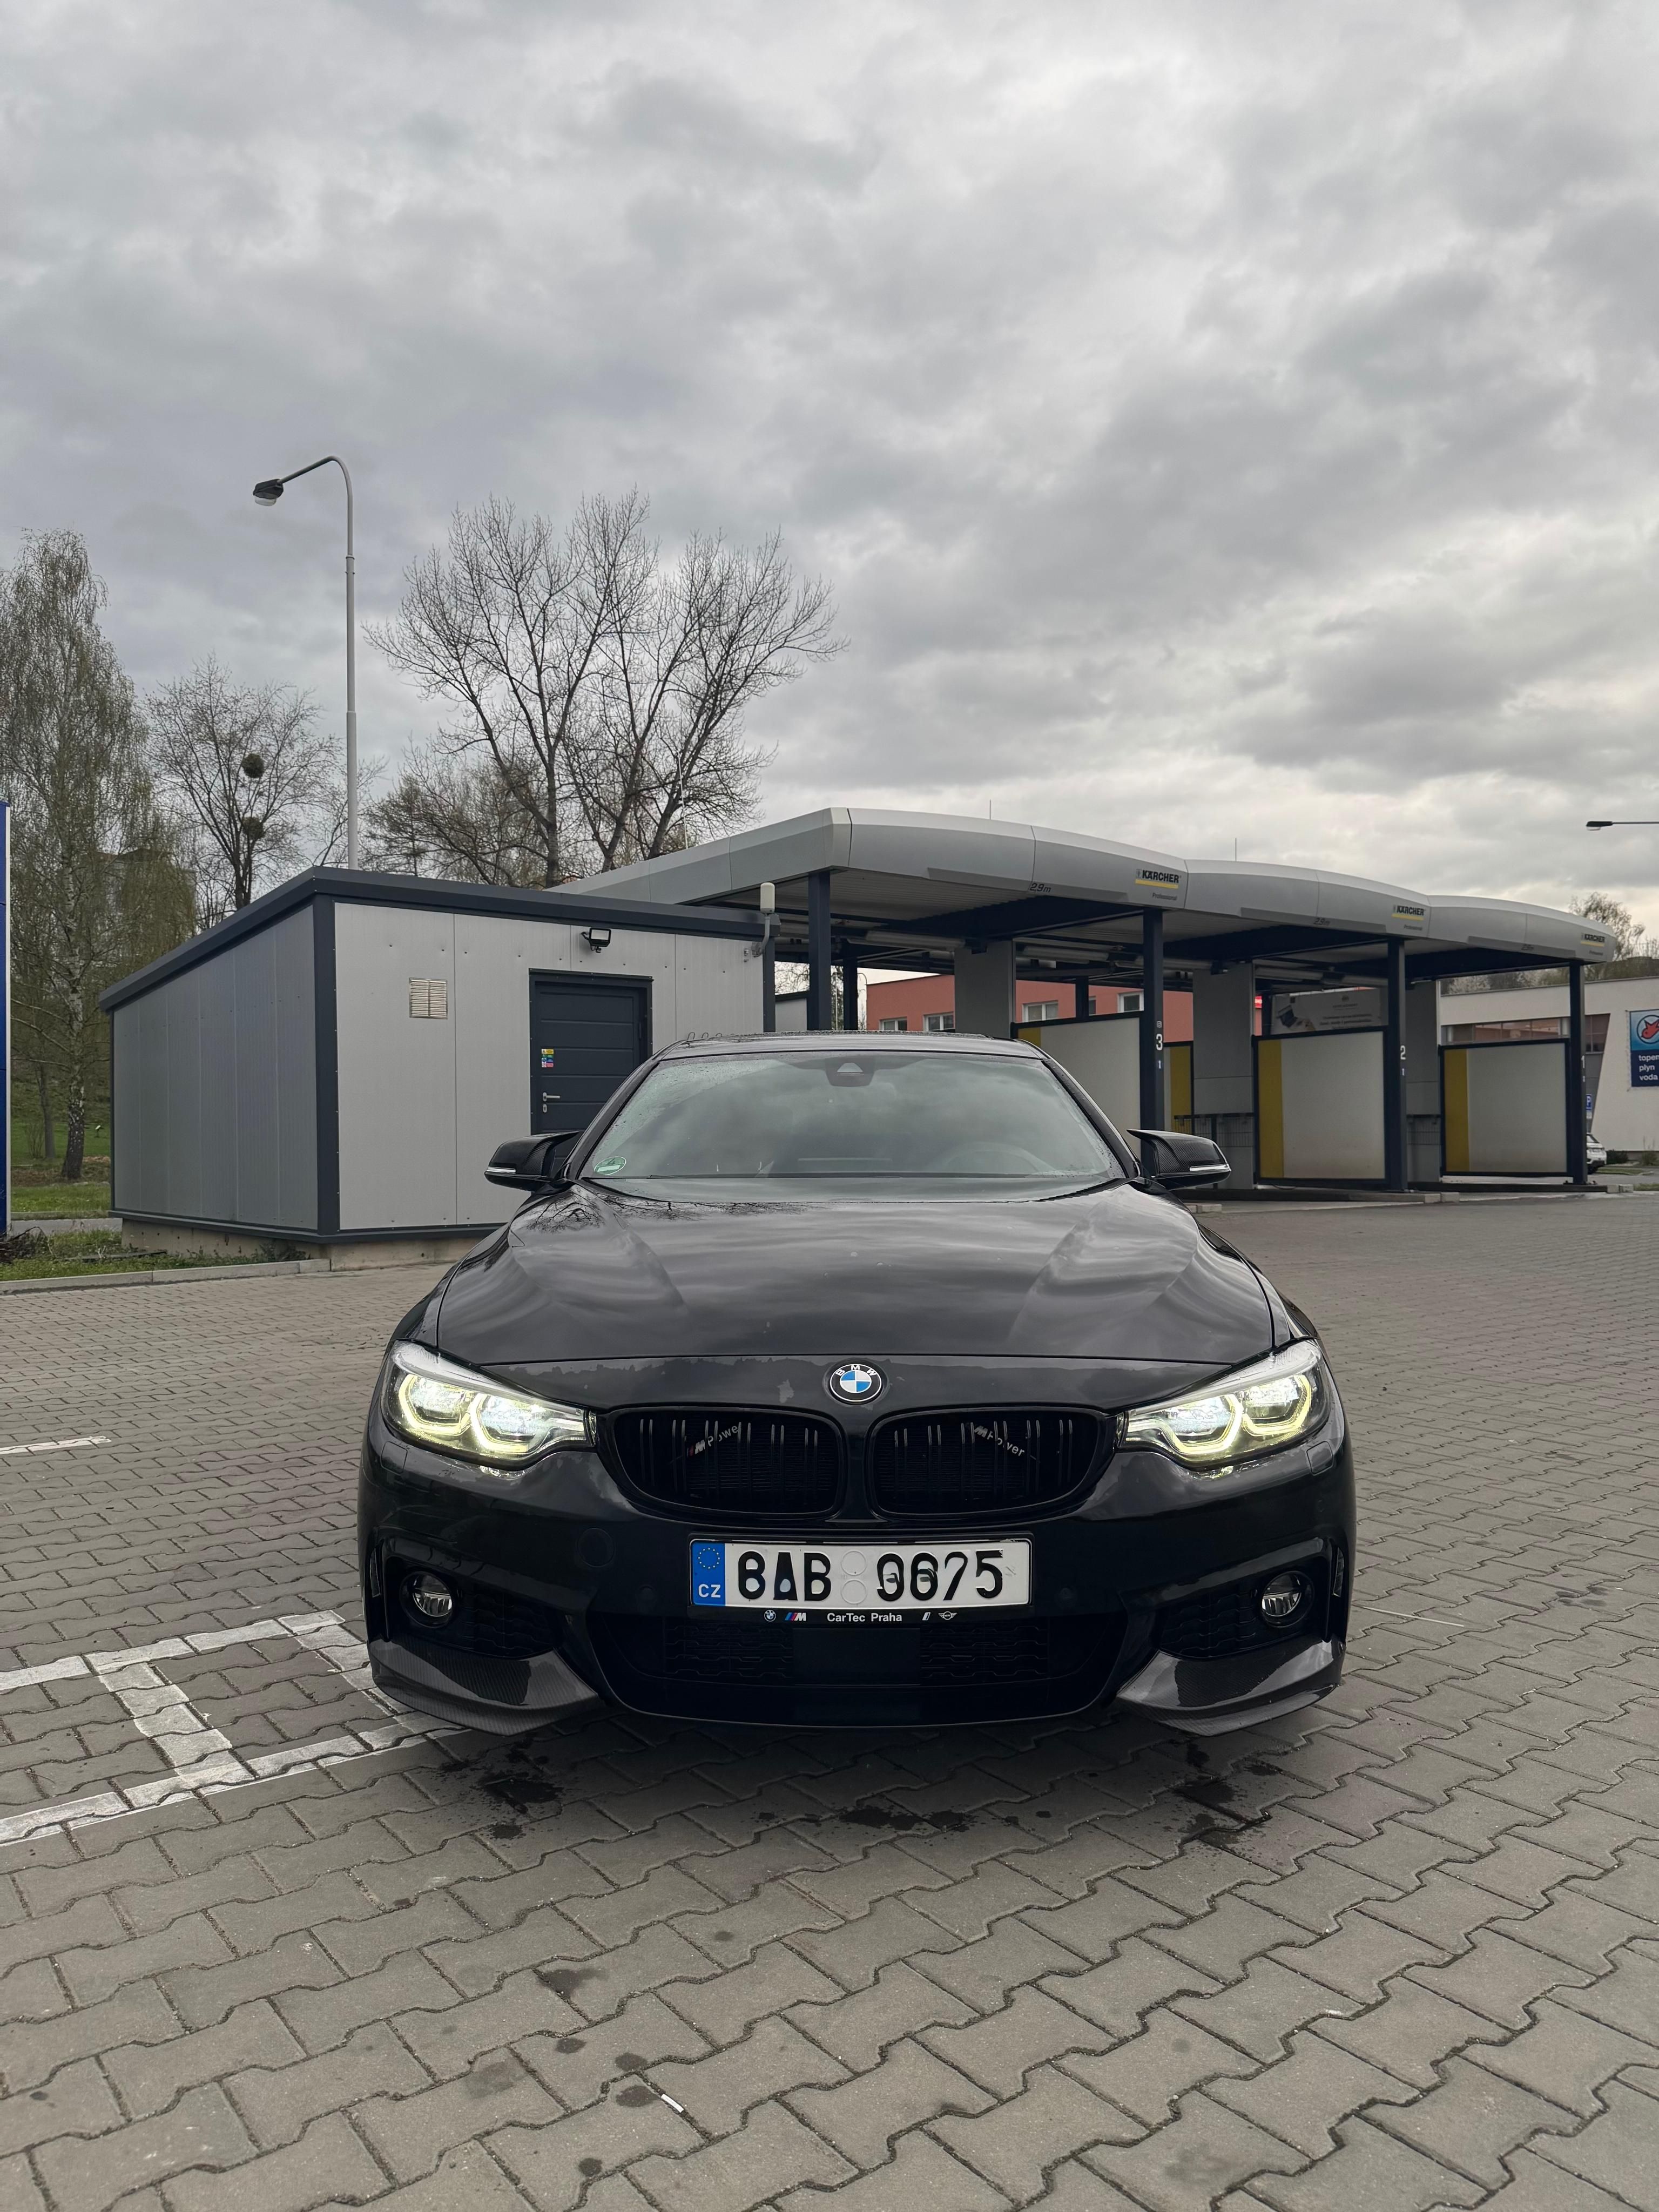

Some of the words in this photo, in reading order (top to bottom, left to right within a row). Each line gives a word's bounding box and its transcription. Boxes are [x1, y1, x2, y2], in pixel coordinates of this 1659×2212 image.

[1156, 1033, 1163, 1051] 3
[1400, 1045, 1406, 1060] 2
[1639, 1064, 1655, 1073] plyn
[835, 1365, 877, 1376] BMW
[698, 1583, 721, 1598] CZ
[827, 1612, 866, 1622] CarTec
[871, 1612, 903, 1622] Praha
